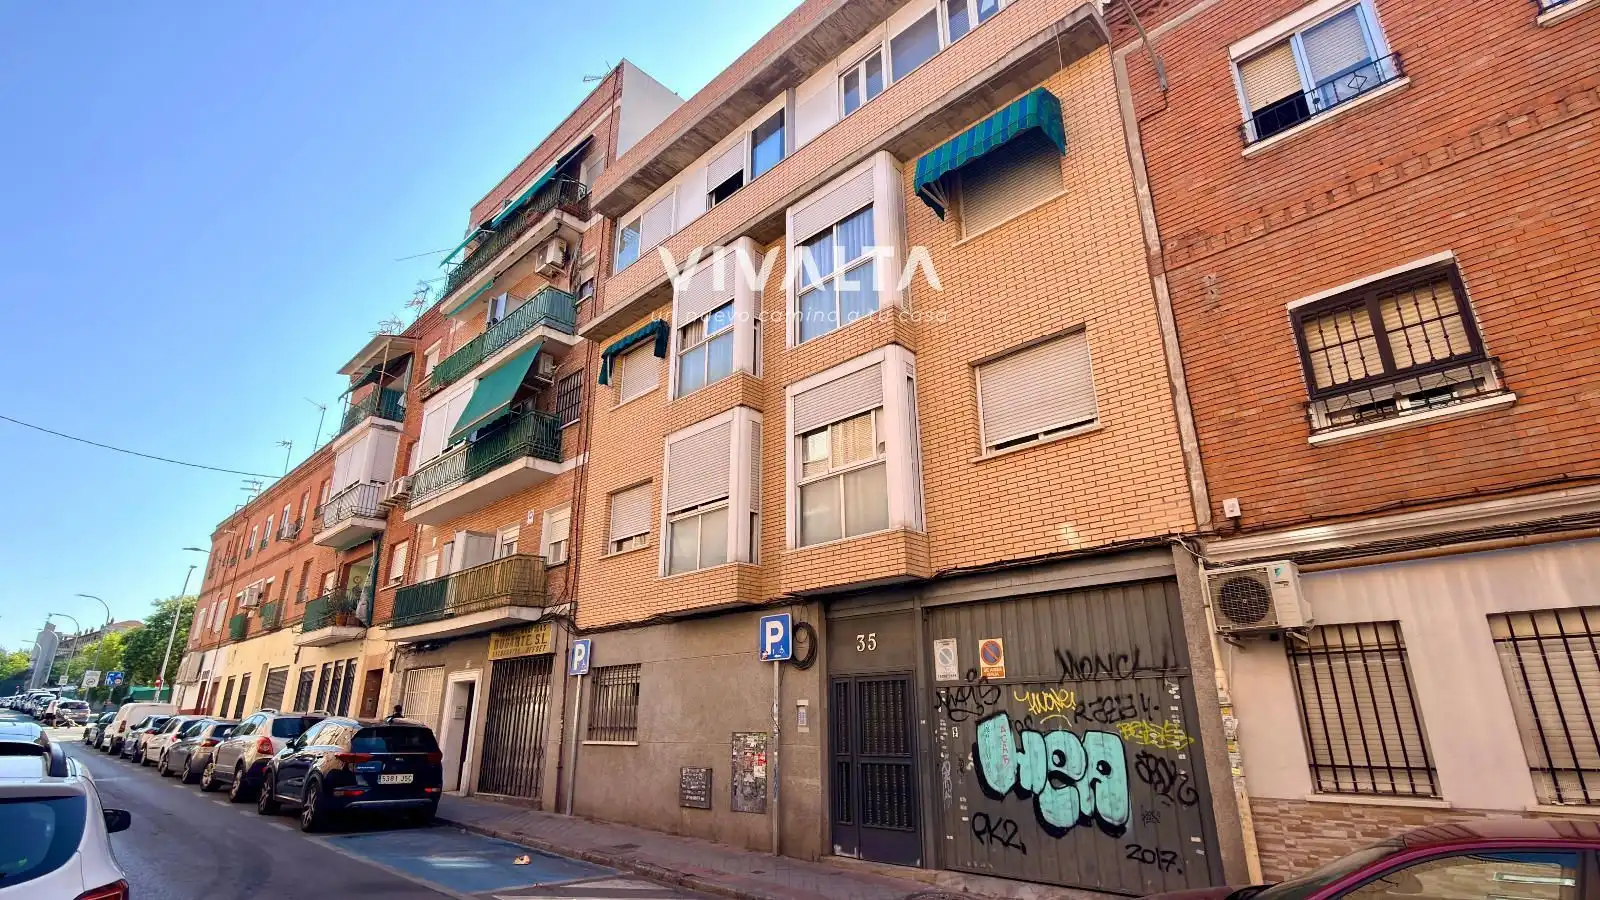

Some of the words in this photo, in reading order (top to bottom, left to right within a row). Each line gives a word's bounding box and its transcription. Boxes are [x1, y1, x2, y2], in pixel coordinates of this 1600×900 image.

[766, 620, 784, 656] P
[856, 633, 877, 652] 35
[574, 643, 586, 671] P
